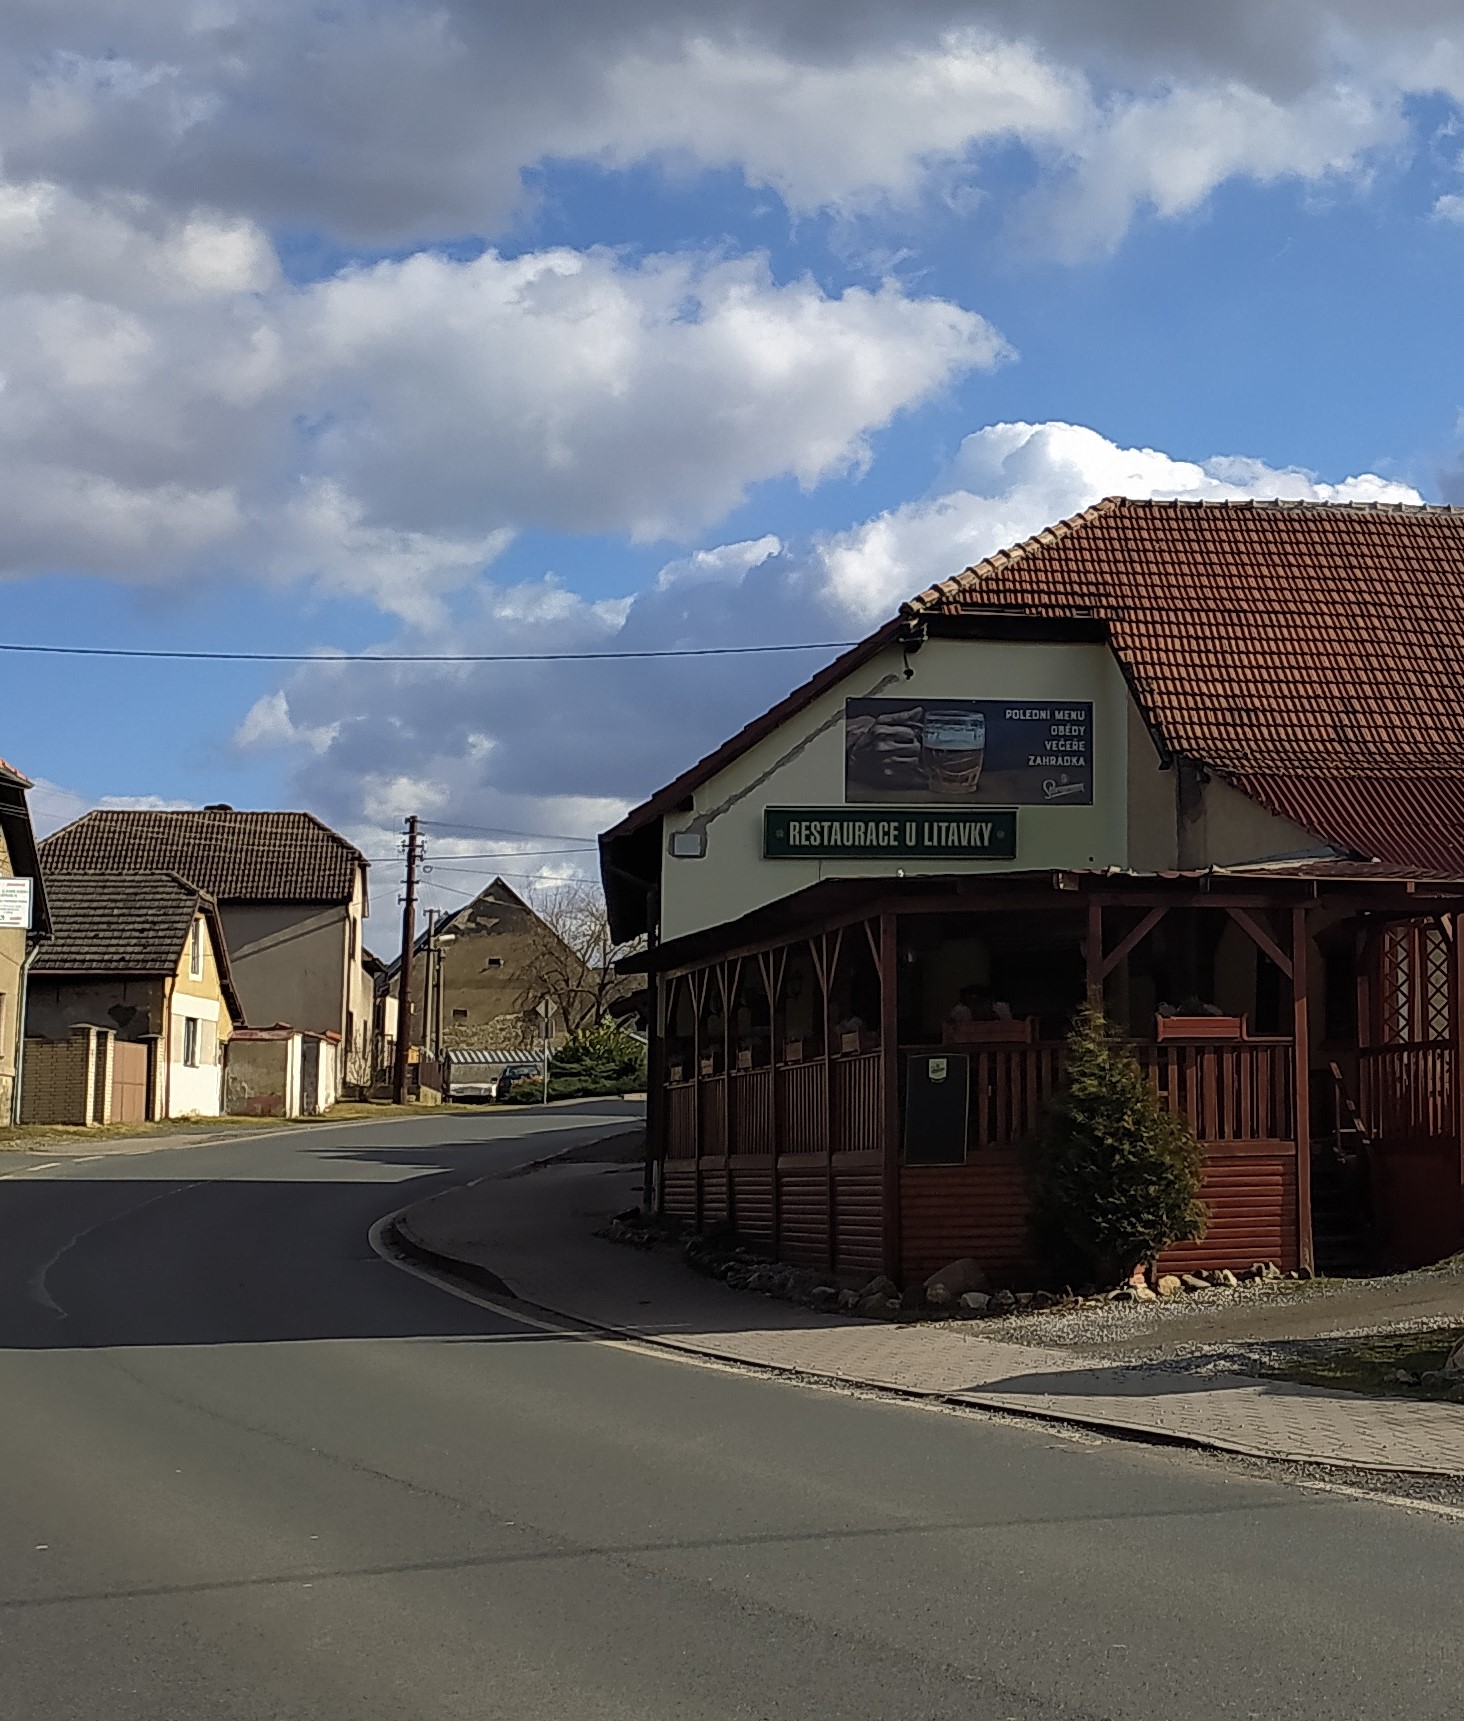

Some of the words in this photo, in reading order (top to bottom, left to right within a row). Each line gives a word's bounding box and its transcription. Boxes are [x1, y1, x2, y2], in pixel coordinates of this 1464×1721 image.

[1054, 710, 1085, 720] MENU
[789, 821, 899, 846] RESTAURACE
[905, 822, 916, 847] U
[924, 822, 993, 847] LITAVKY
